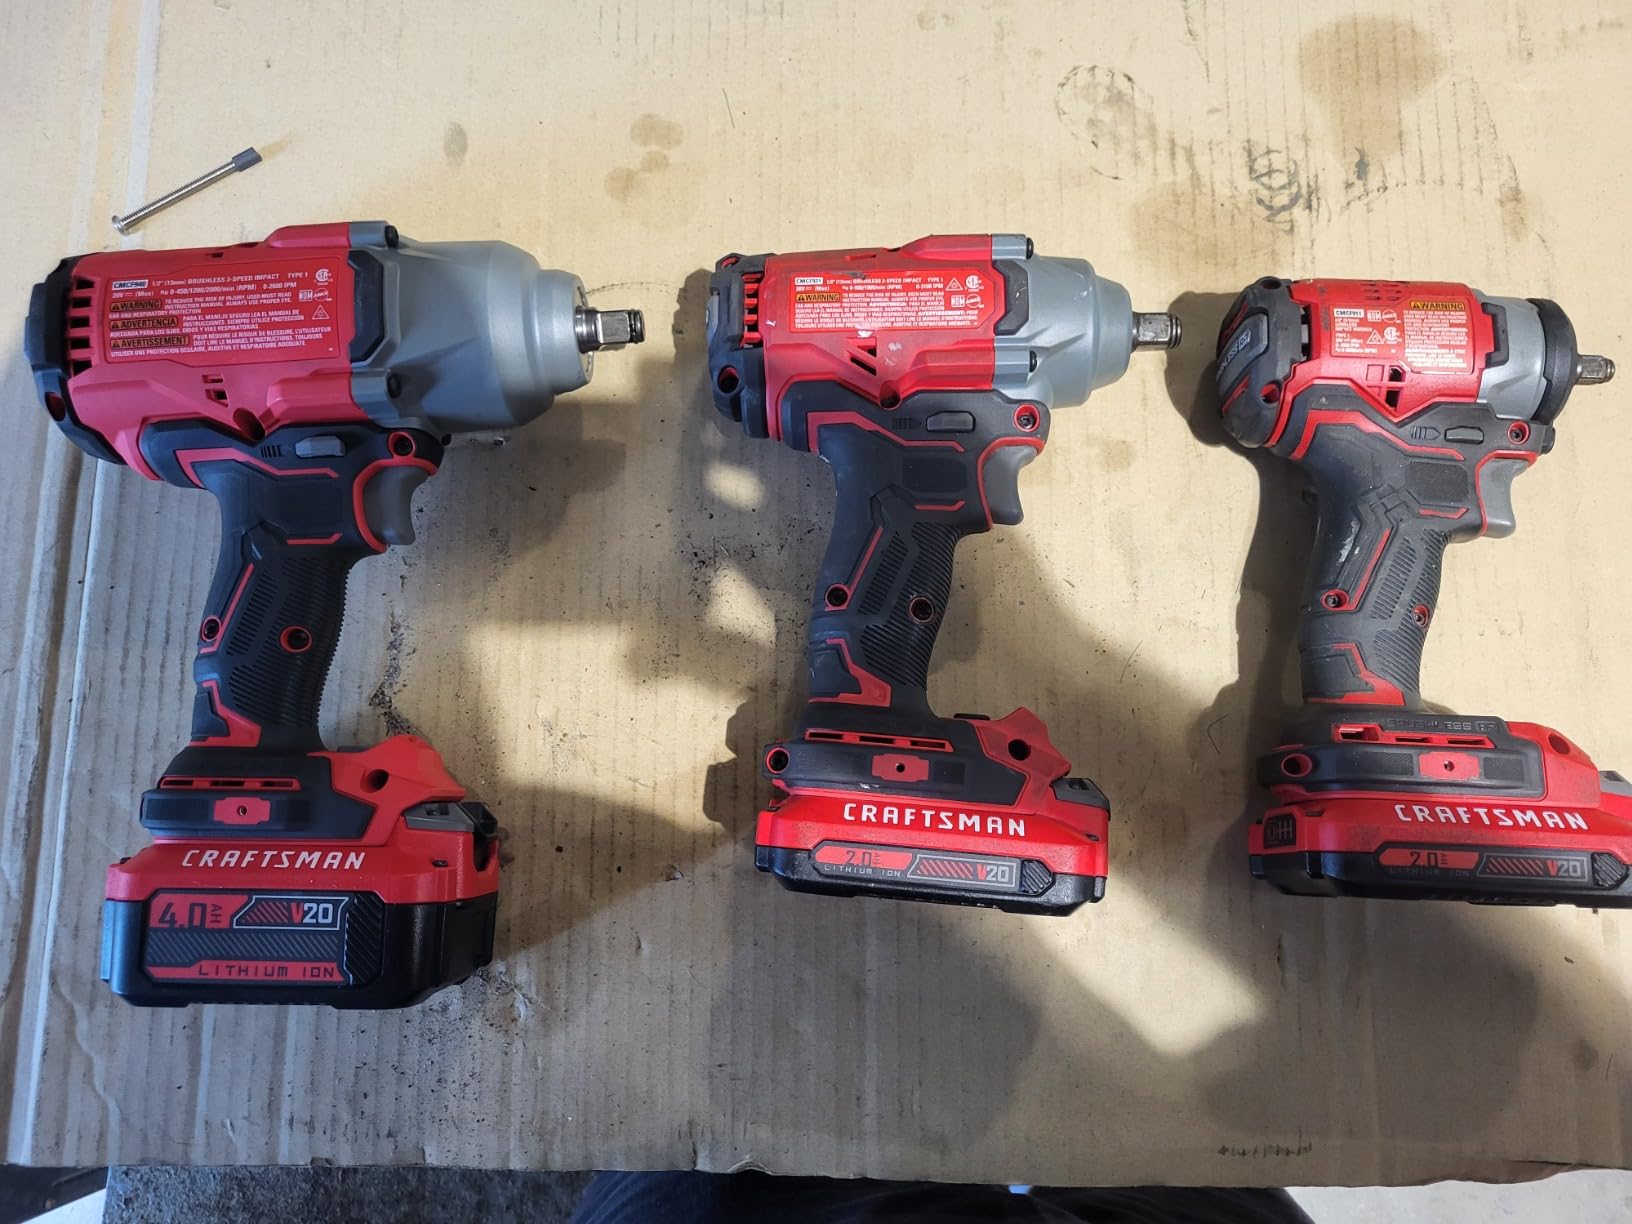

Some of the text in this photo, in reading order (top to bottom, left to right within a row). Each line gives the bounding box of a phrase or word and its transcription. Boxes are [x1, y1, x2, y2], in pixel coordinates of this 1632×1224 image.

[121, 300, 160, 310] WARNING
[122, 318, 176, 328] ADVERTENCIA
[121, 337, 186, 347] AVERTISSEMENT
[844, 803, 1025, 837] CRAFTSMAN
[1394, 804, 1588, 830] CRAFTSMAN
[182, 850, 365, 870] CRAFTSMAN
[846, 850, 872, 866] 2.0
[1410, 851, 1438, 867] 2.0
[824, 864, 901, 878] LITHIUM ION
[976, 864, 1009, 882] V20
[1547, 860, 1580, 877] V20
[158, 902, 207, 928] 4.0
[291, 902, 333, 924] V20
[200, 966, 334, 977] LITHIUM ION
